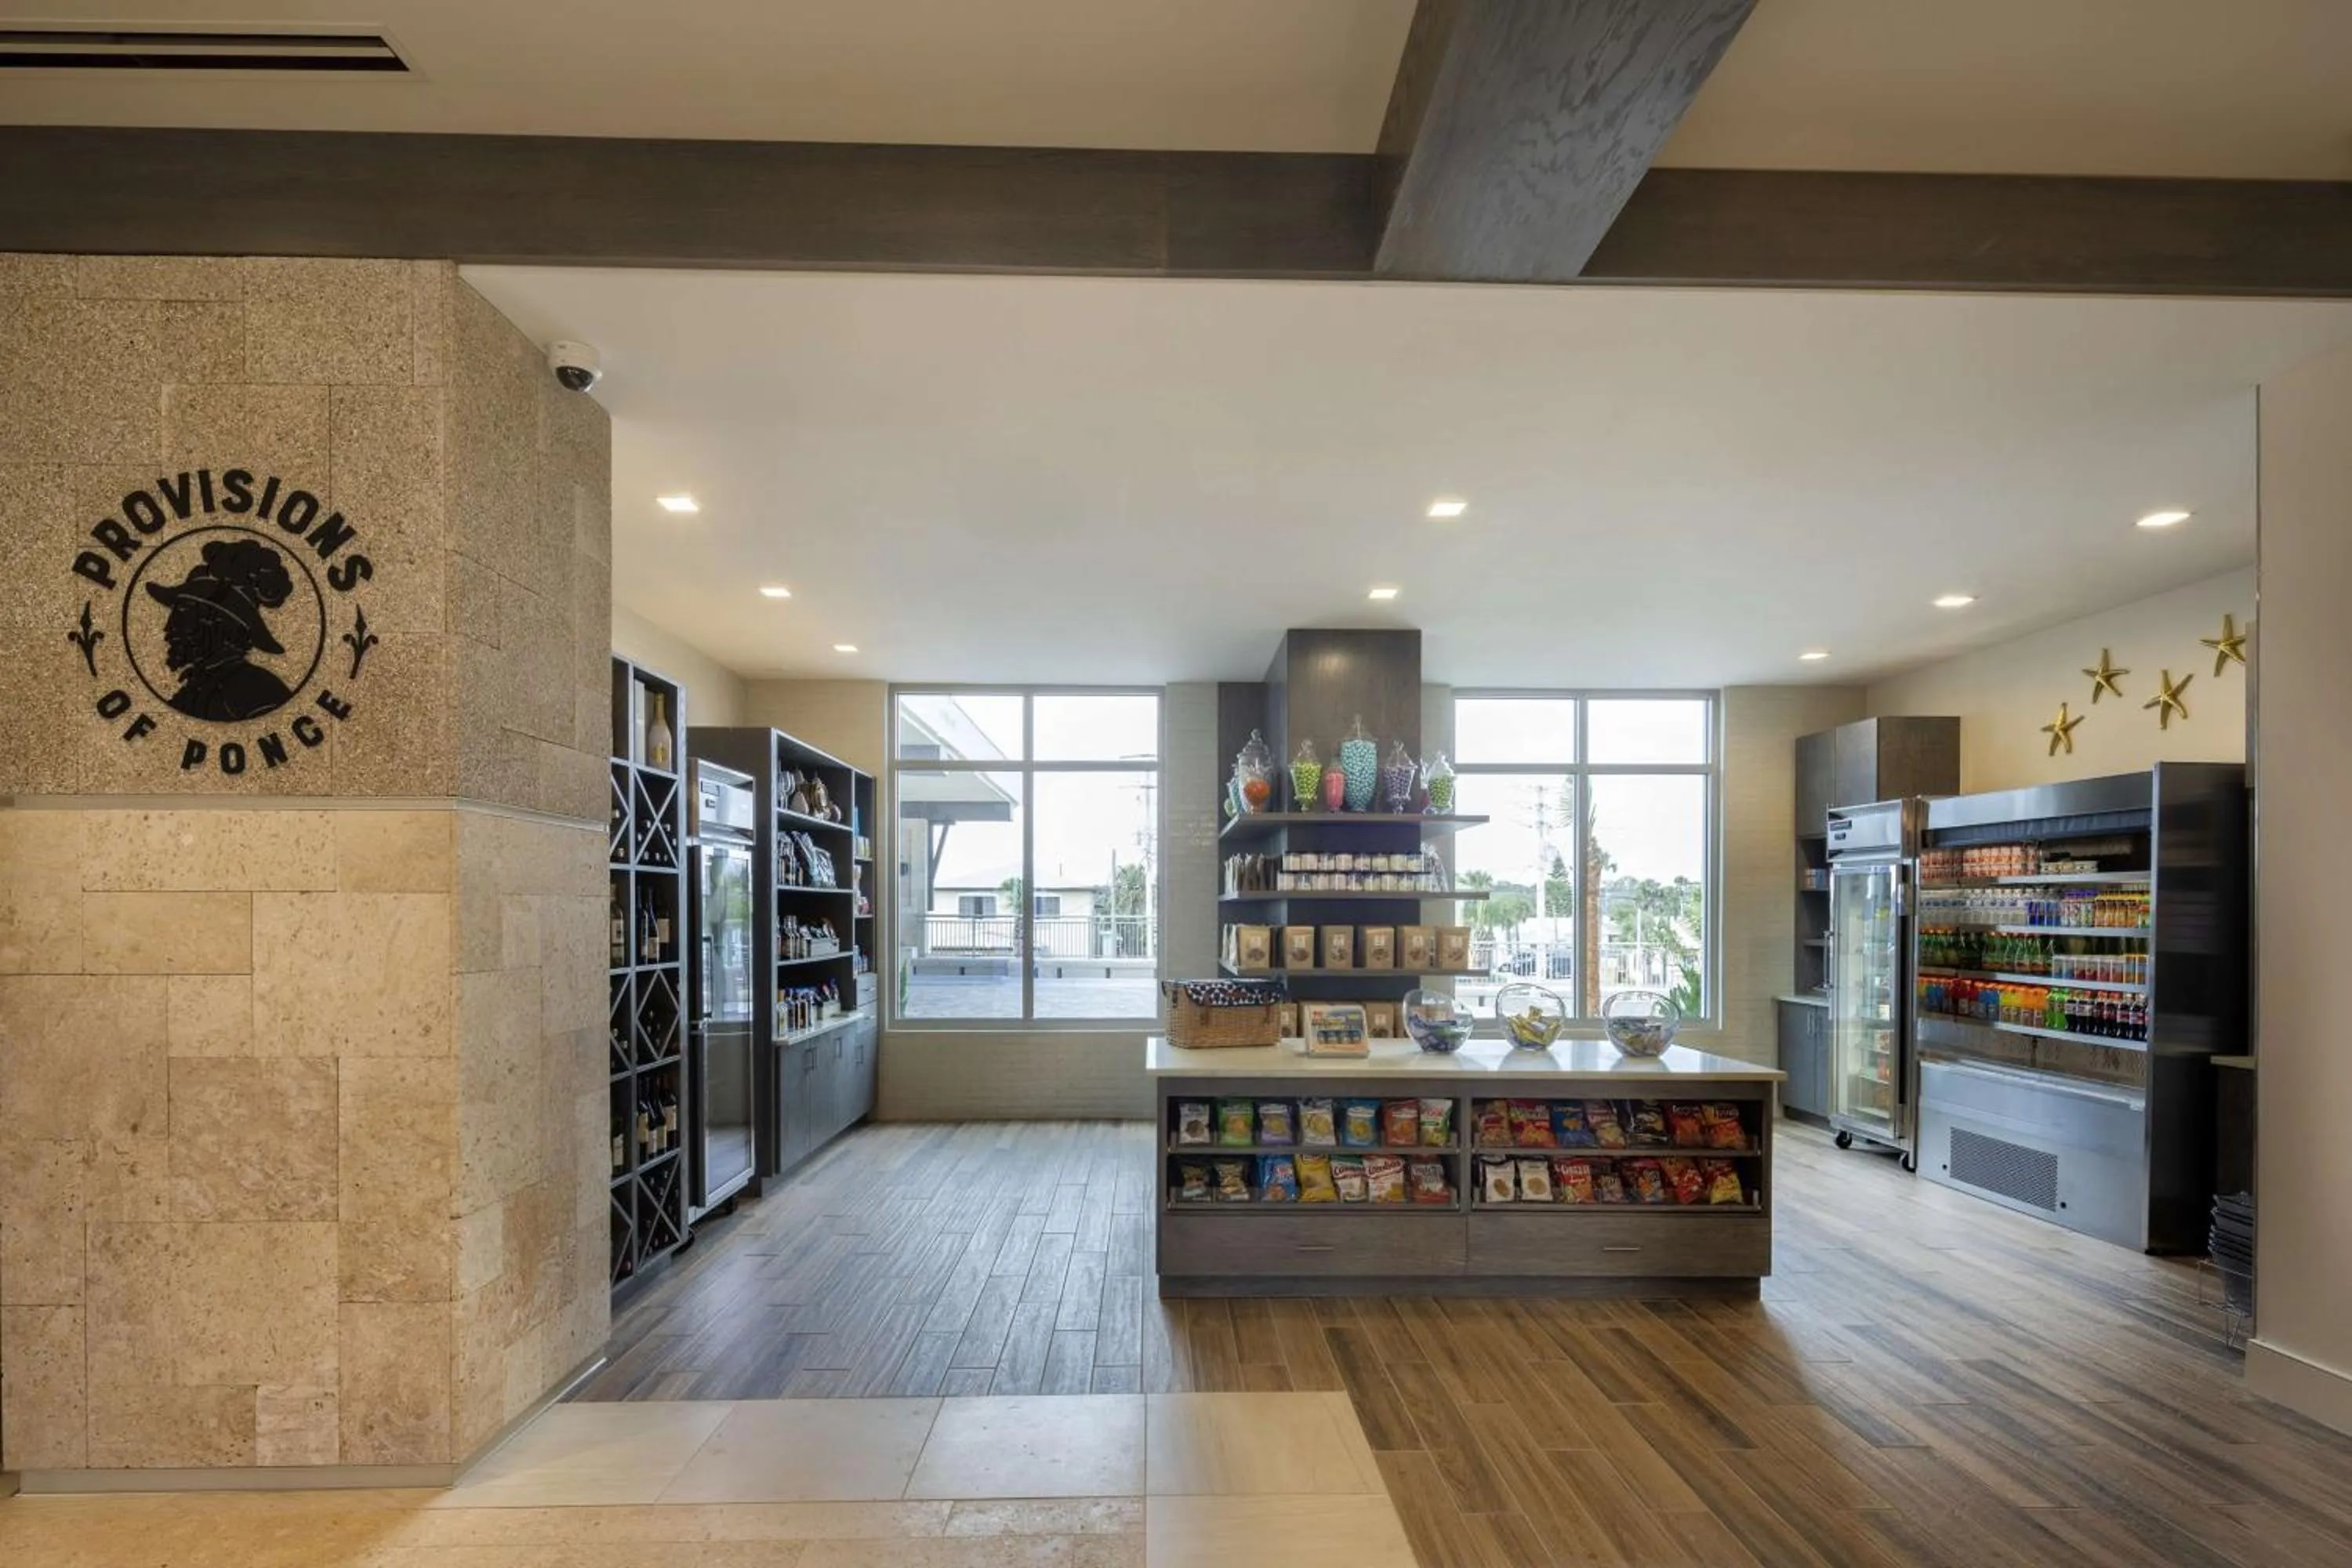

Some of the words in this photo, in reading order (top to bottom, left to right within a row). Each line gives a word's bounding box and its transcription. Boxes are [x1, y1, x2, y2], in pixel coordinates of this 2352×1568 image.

[71, 469, 373, 592] PROVISIONS
[96, 689, 157, 742] OF
[180, 689, 352, 775] PONCE
